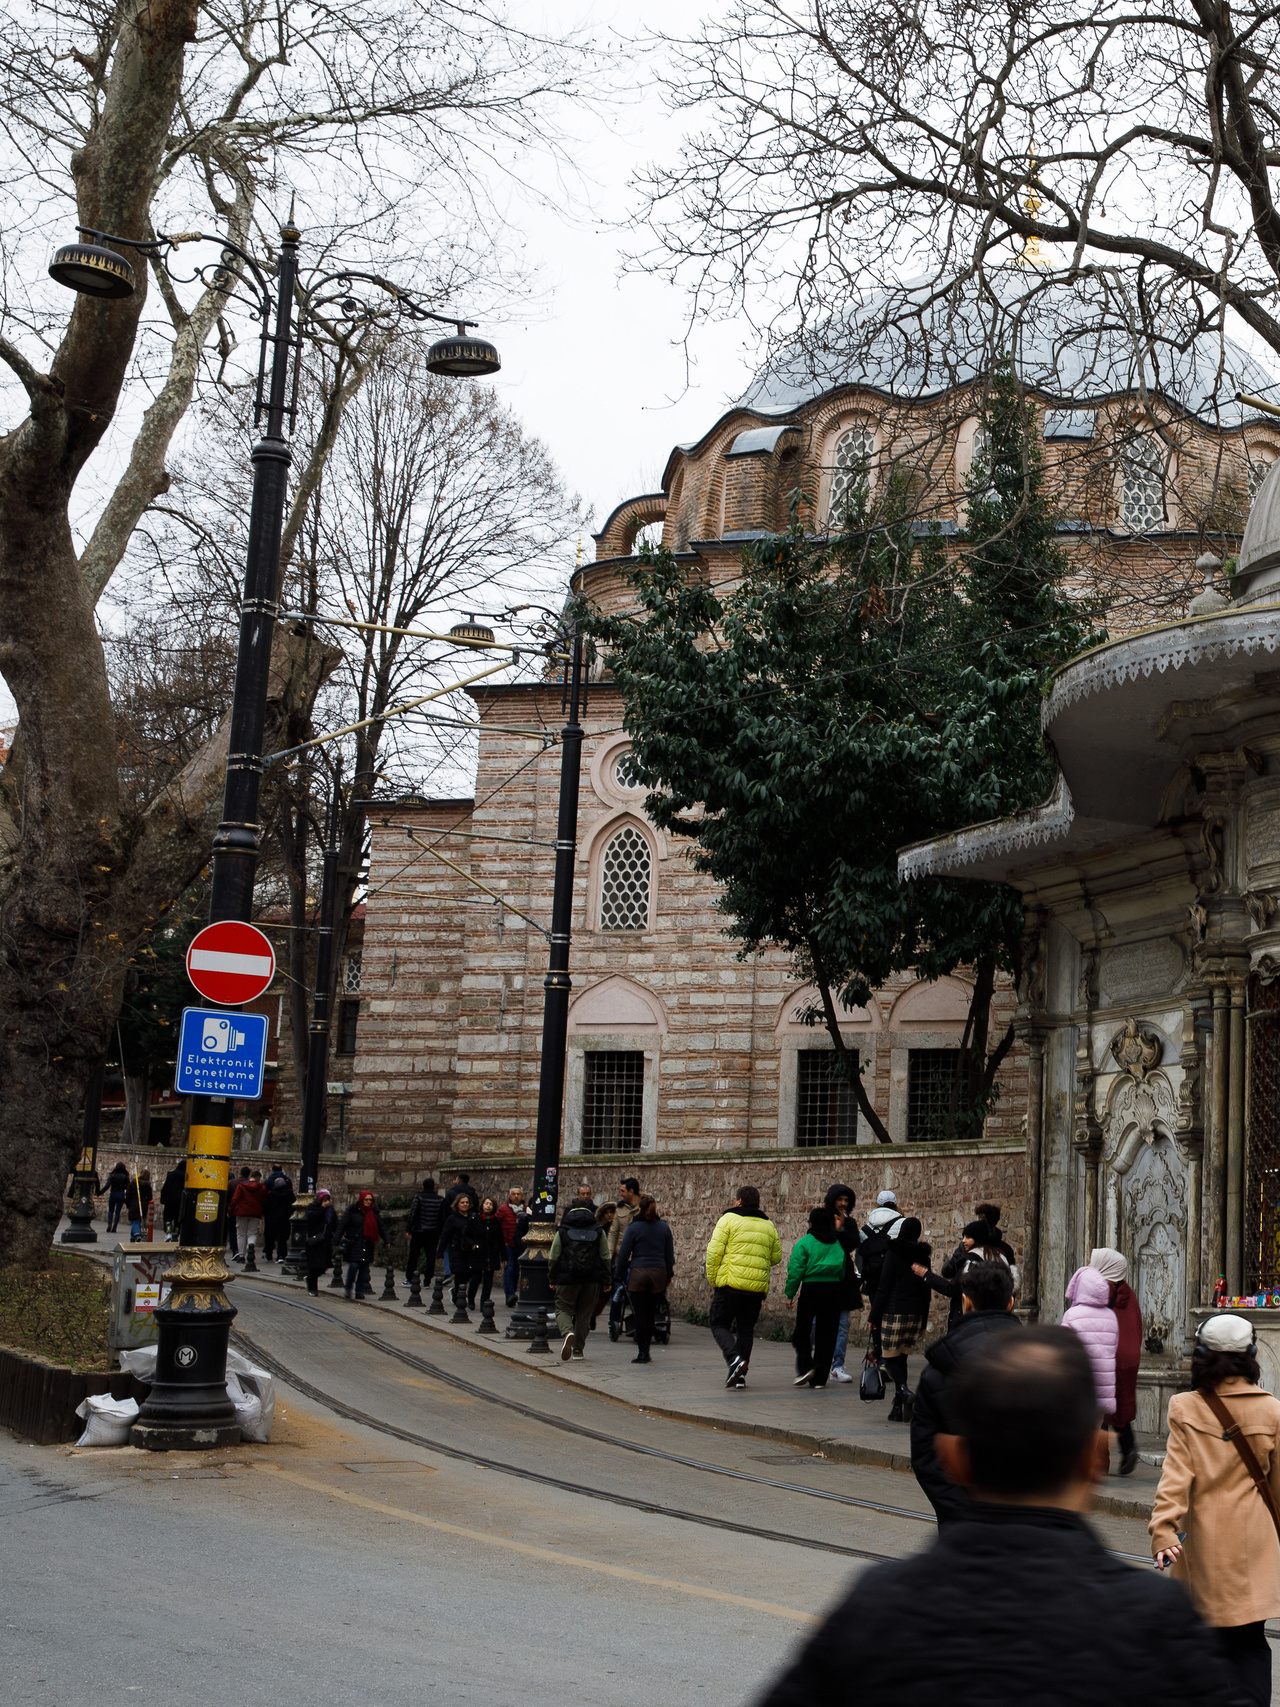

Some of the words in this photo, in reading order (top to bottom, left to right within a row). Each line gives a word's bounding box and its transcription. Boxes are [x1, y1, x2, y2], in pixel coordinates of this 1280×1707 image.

[187, 1054, 254, 1068] Elektronik
[185, 1066, 255, 1080] Denetleme
[194, 1078, 243, 1091] Sistemi
